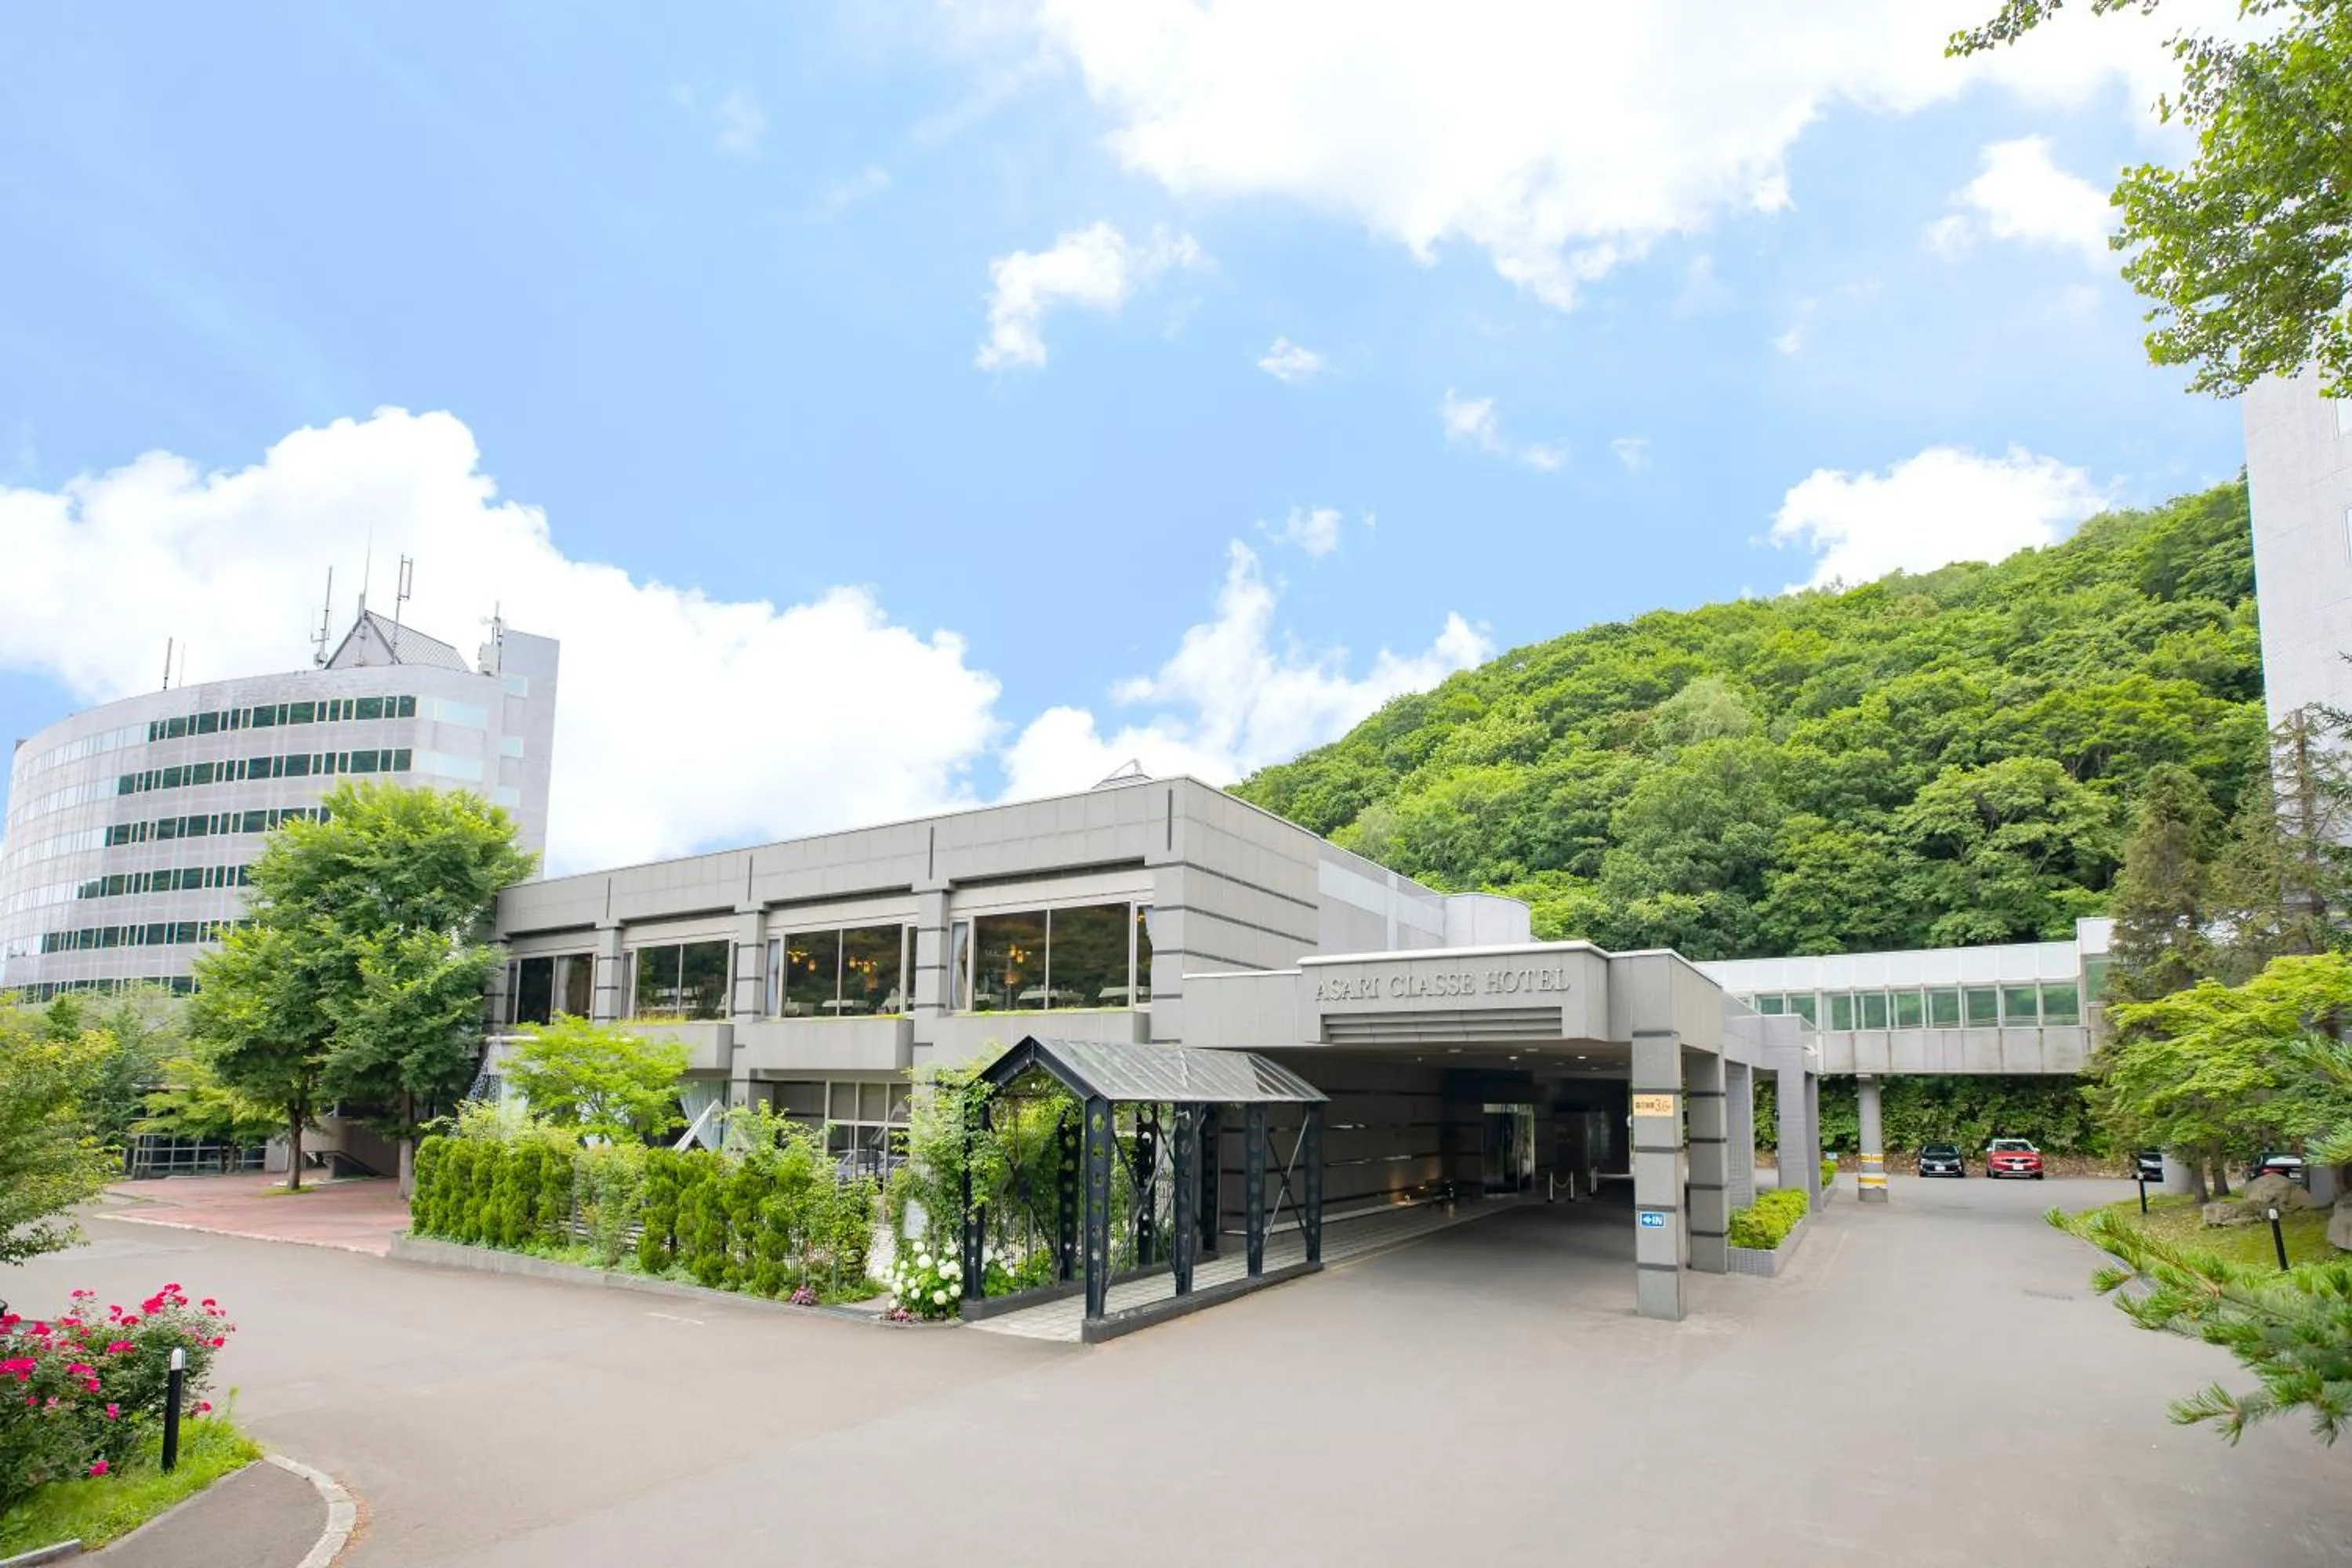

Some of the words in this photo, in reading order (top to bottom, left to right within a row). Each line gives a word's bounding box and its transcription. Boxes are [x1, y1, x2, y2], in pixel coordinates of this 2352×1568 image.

[1316, 978, 1379, 1002] ASARI
[1390, 973, 1475, 998] CLASSE
[1484, 967, 1570, 994] HOTEL
